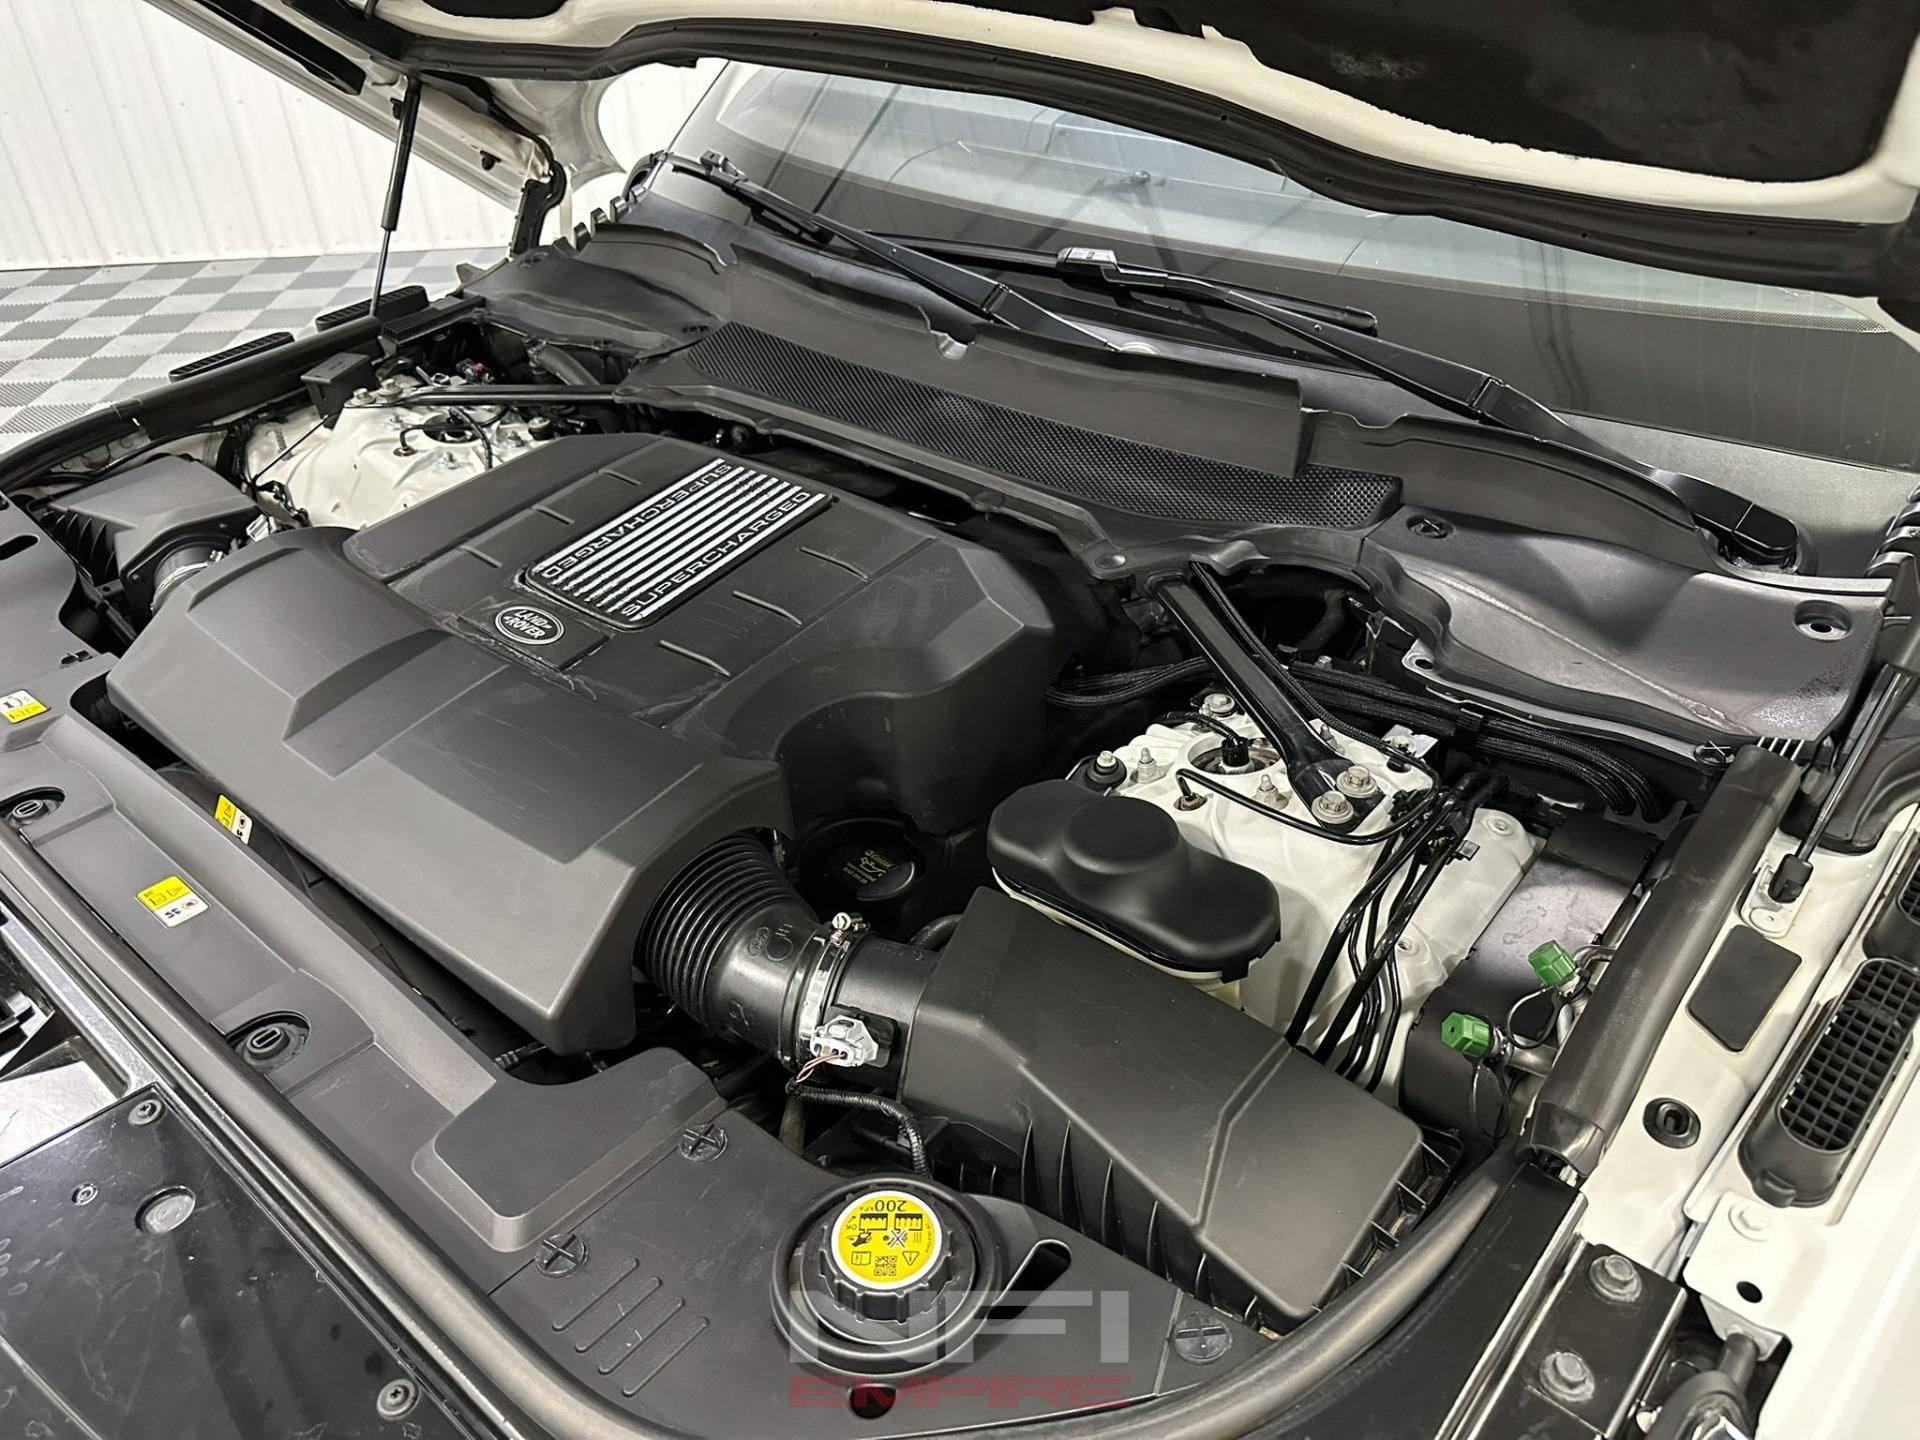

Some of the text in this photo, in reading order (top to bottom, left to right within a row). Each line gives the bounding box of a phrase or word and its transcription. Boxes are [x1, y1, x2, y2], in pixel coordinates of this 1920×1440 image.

[541, 464, 732, 578] SUPERCHARGED
[621, 491, 812, 616] SUPERCHARGED
[505, 616, 545, 638] ROVER
[514, 610, 548, 627] LAND
[875, 1200, 908, 1211] 200
